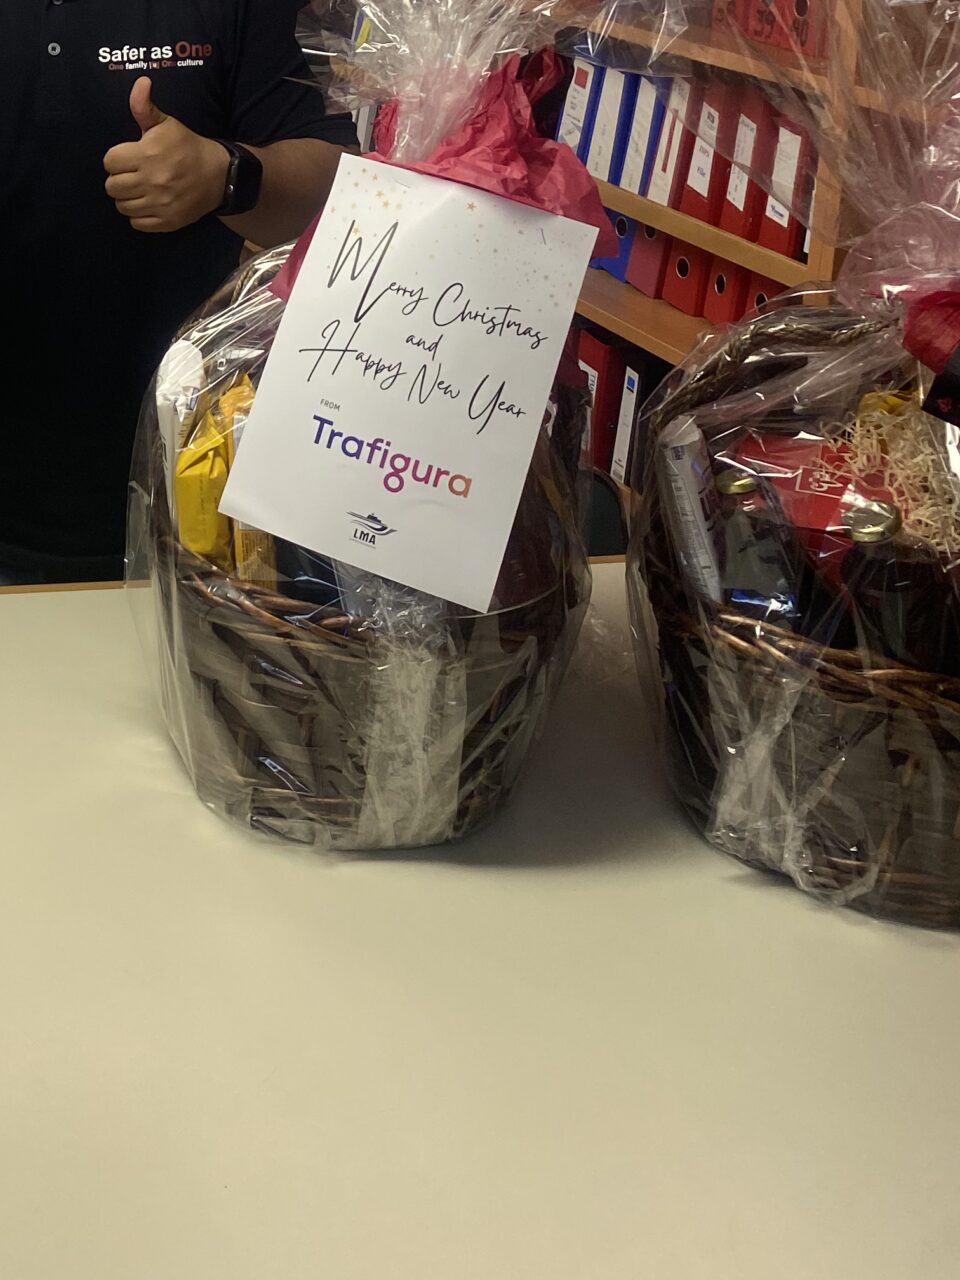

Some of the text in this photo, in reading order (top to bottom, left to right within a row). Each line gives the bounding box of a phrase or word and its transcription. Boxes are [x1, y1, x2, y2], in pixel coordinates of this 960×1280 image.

[98, 40, 213, 63] Safer as One
[125, 61, 148, 70] family
[177, 58, 204, 67] culture
[327, 219, 548, 349] Merry Christmas
[405, 334, 444, 361] and
[298, 320, 526, 435] Happy New Year
[320, 398, 341, 411] FROM
[312, 414, 472, 498] Trafigura
[353, 529, 377, 545] LMA
